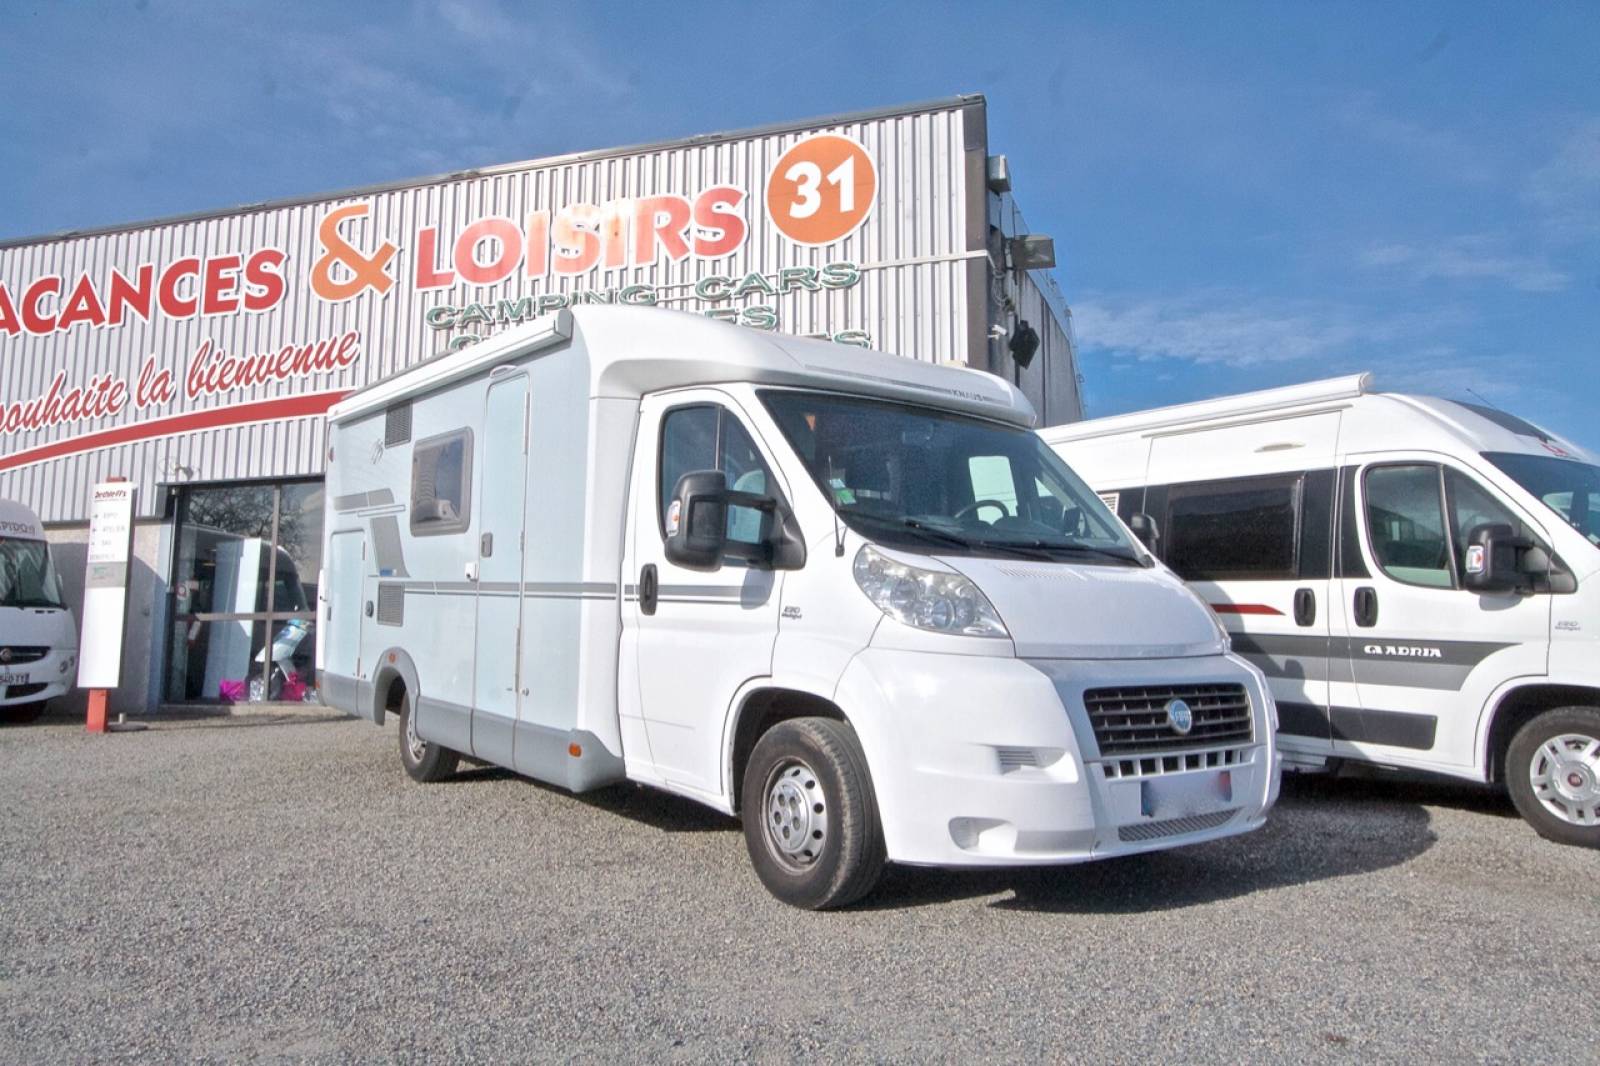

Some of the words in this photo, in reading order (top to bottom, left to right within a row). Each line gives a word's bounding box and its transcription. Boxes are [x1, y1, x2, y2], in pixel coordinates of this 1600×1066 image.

[311, 203, 401, 303] &
[416, 186, 747, 289] LOISIRS
[784, 155, 856, 219] 31
[425, 284, 658, 330] CAMPING
[695, 263, 860, 302] CARS
[136, 355, 175, 411] la
[187, 331, 360, 399] bienvenue
[1385, 645, 1442, 658] ADRIA
